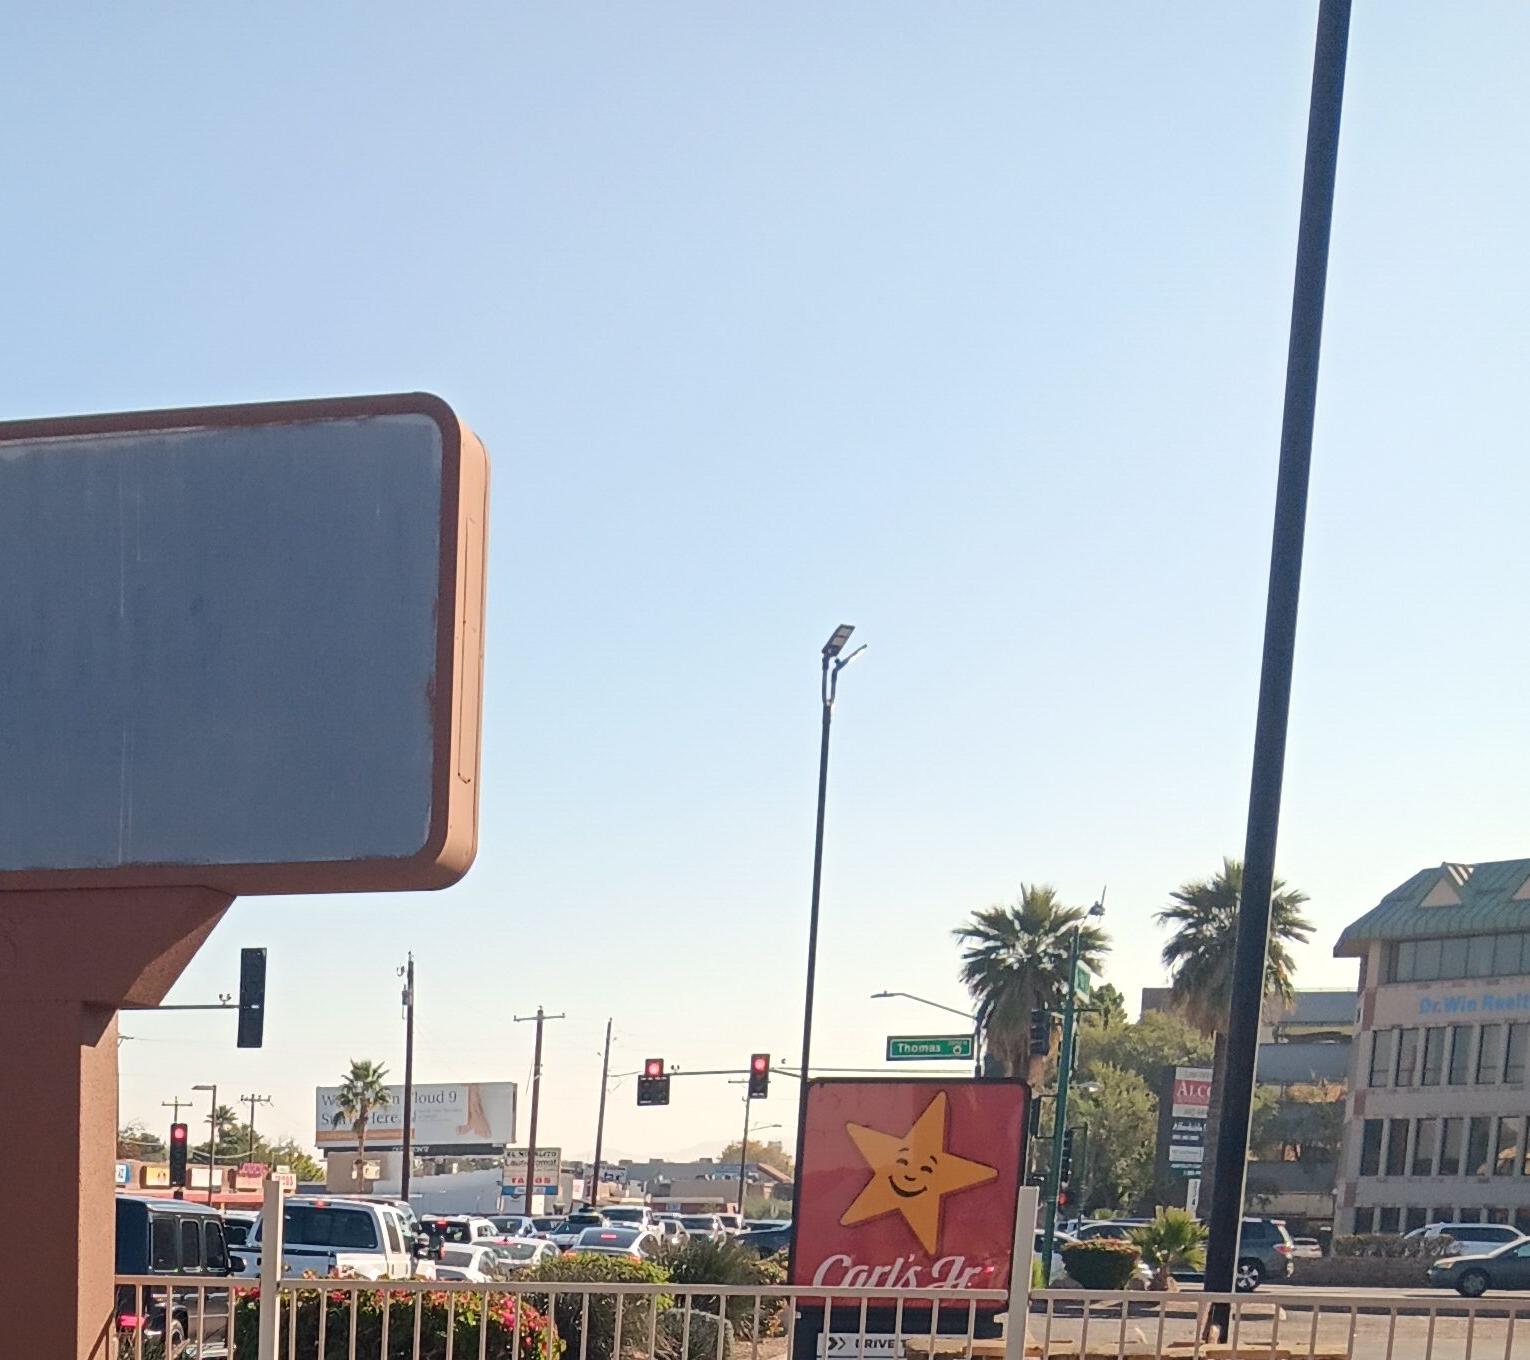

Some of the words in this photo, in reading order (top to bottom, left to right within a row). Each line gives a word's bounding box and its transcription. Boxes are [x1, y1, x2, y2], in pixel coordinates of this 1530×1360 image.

[897, 1043, 941, 1053] Thomas
[412, 1090, 445, 1105] loud
[448, 1090, 457, 1104] 9
[511, 1177, 552, 1185] TAOS
[812, 1253, 923, 1289] Carl's
